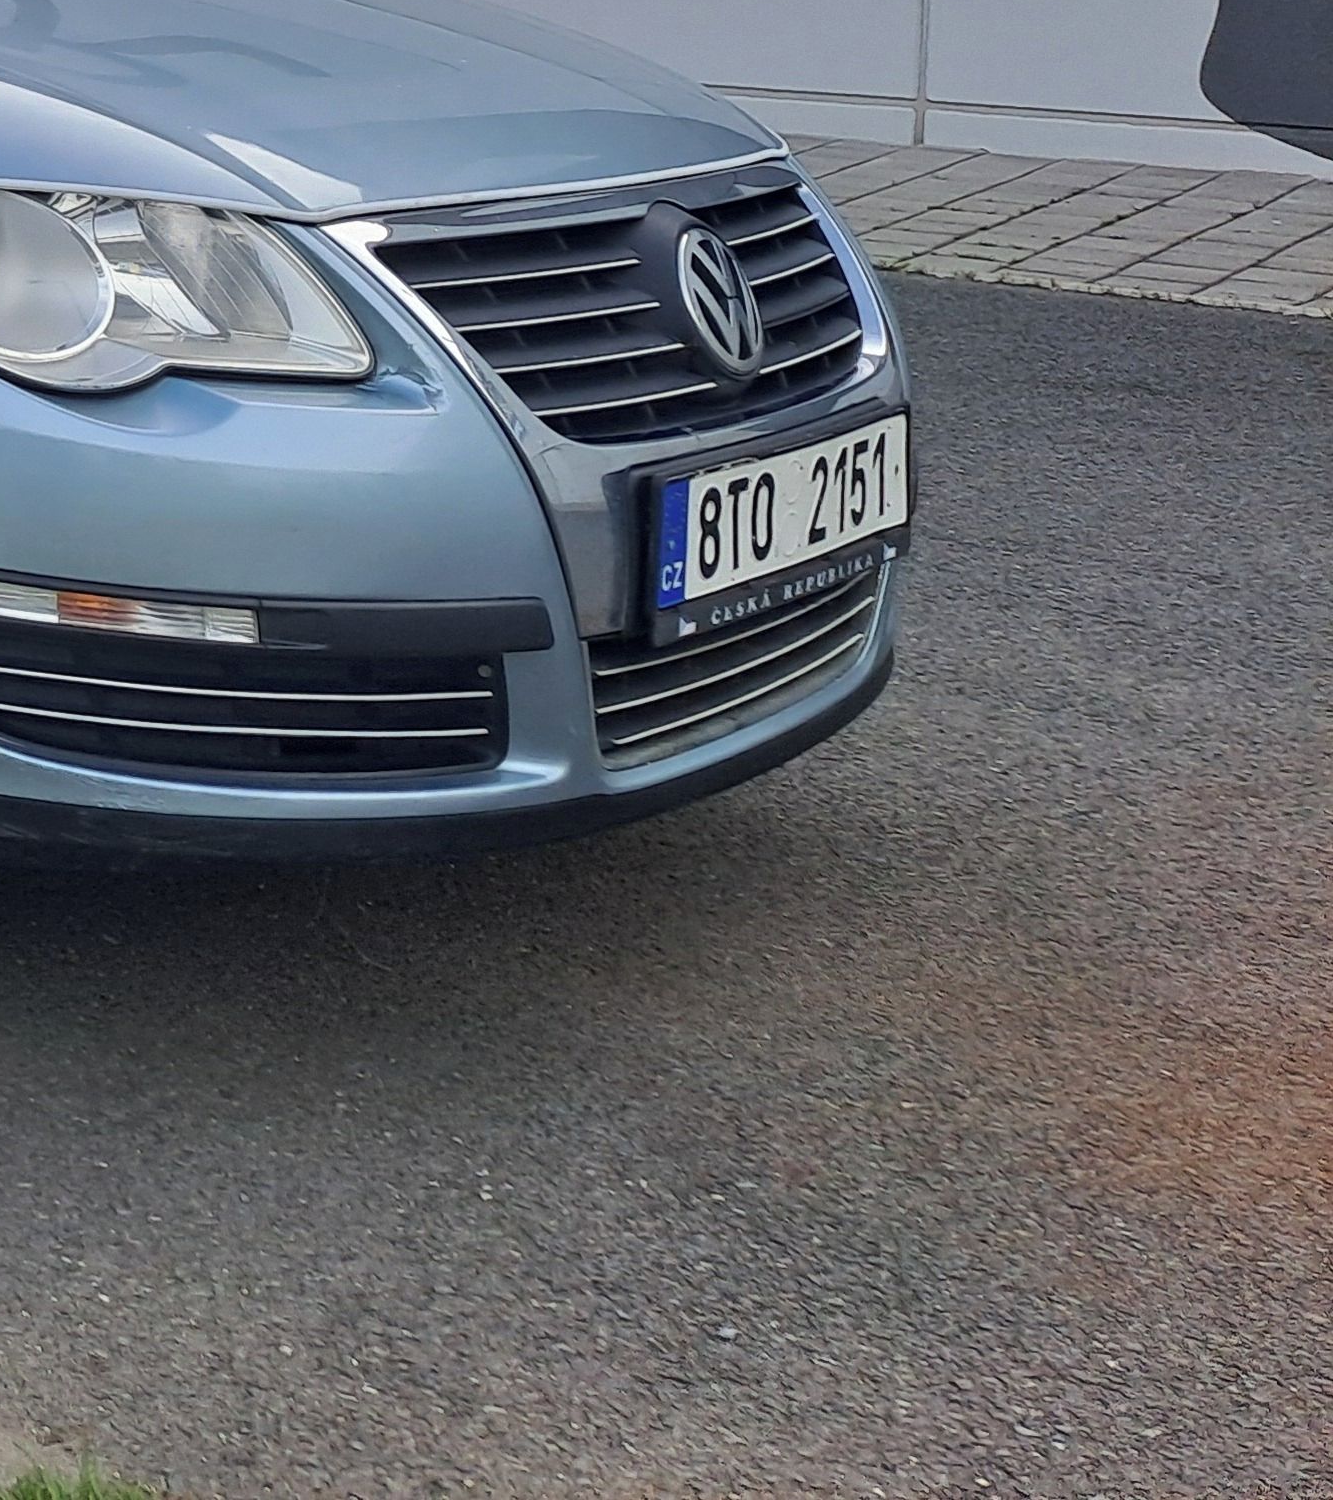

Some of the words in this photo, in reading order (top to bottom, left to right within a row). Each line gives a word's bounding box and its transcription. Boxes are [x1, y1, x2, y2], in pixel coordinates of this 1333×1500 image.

[808, 432, 886, 546] 2151
[661, 560, 684, 592] CZ
[783, 553, 875, 601] REPUBLIKA
